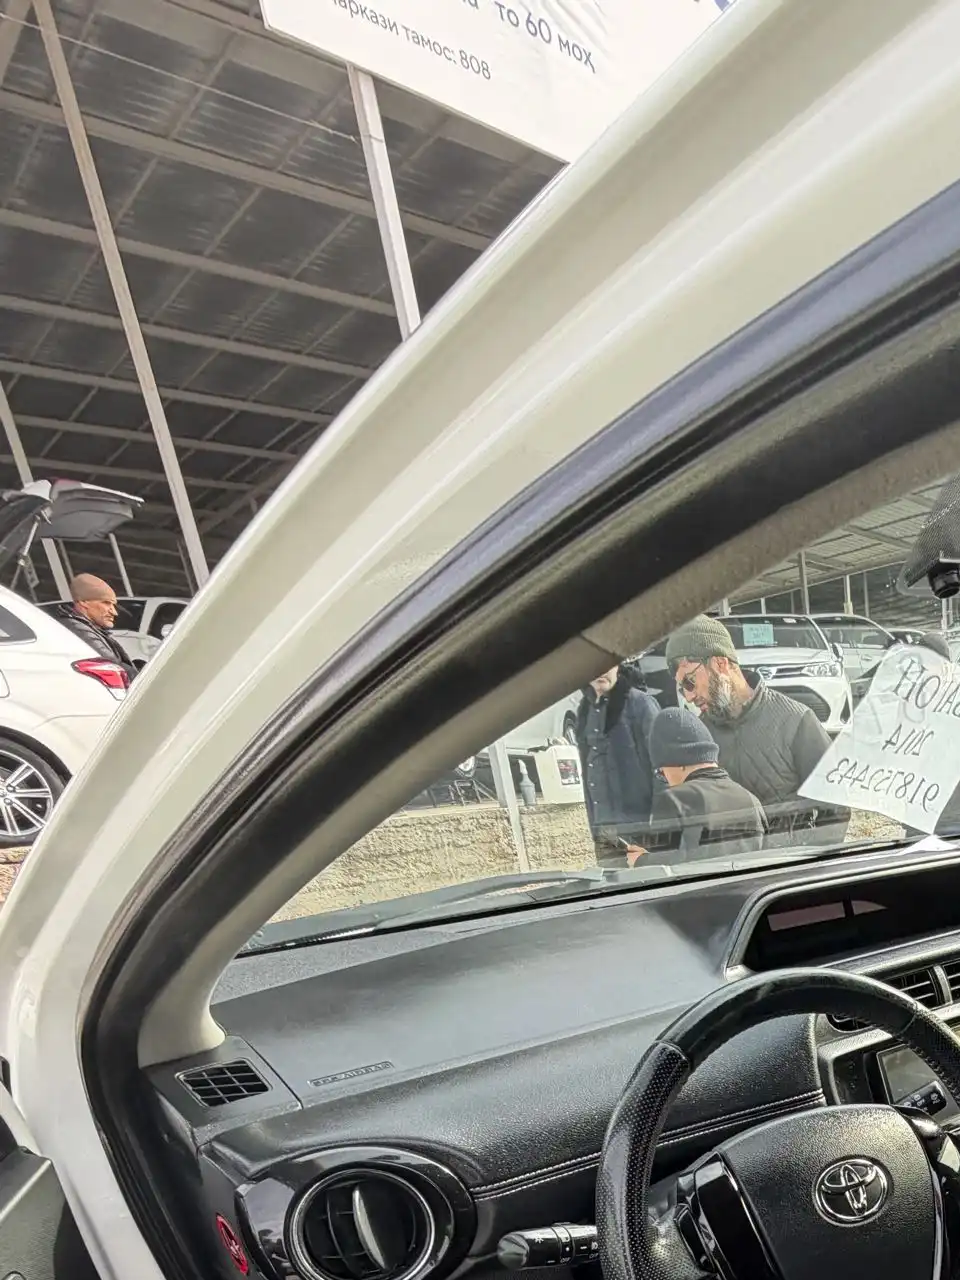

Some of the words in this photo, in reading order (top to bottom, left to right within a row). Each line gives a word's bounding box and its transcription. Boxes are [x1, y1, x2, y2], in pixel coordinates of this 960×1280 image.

[494, 1, 519, 28] то
[526, 12, 552, 44] 60
[401, 24, 457, 64] тамос:
[459, 50, 491, 80] 808
